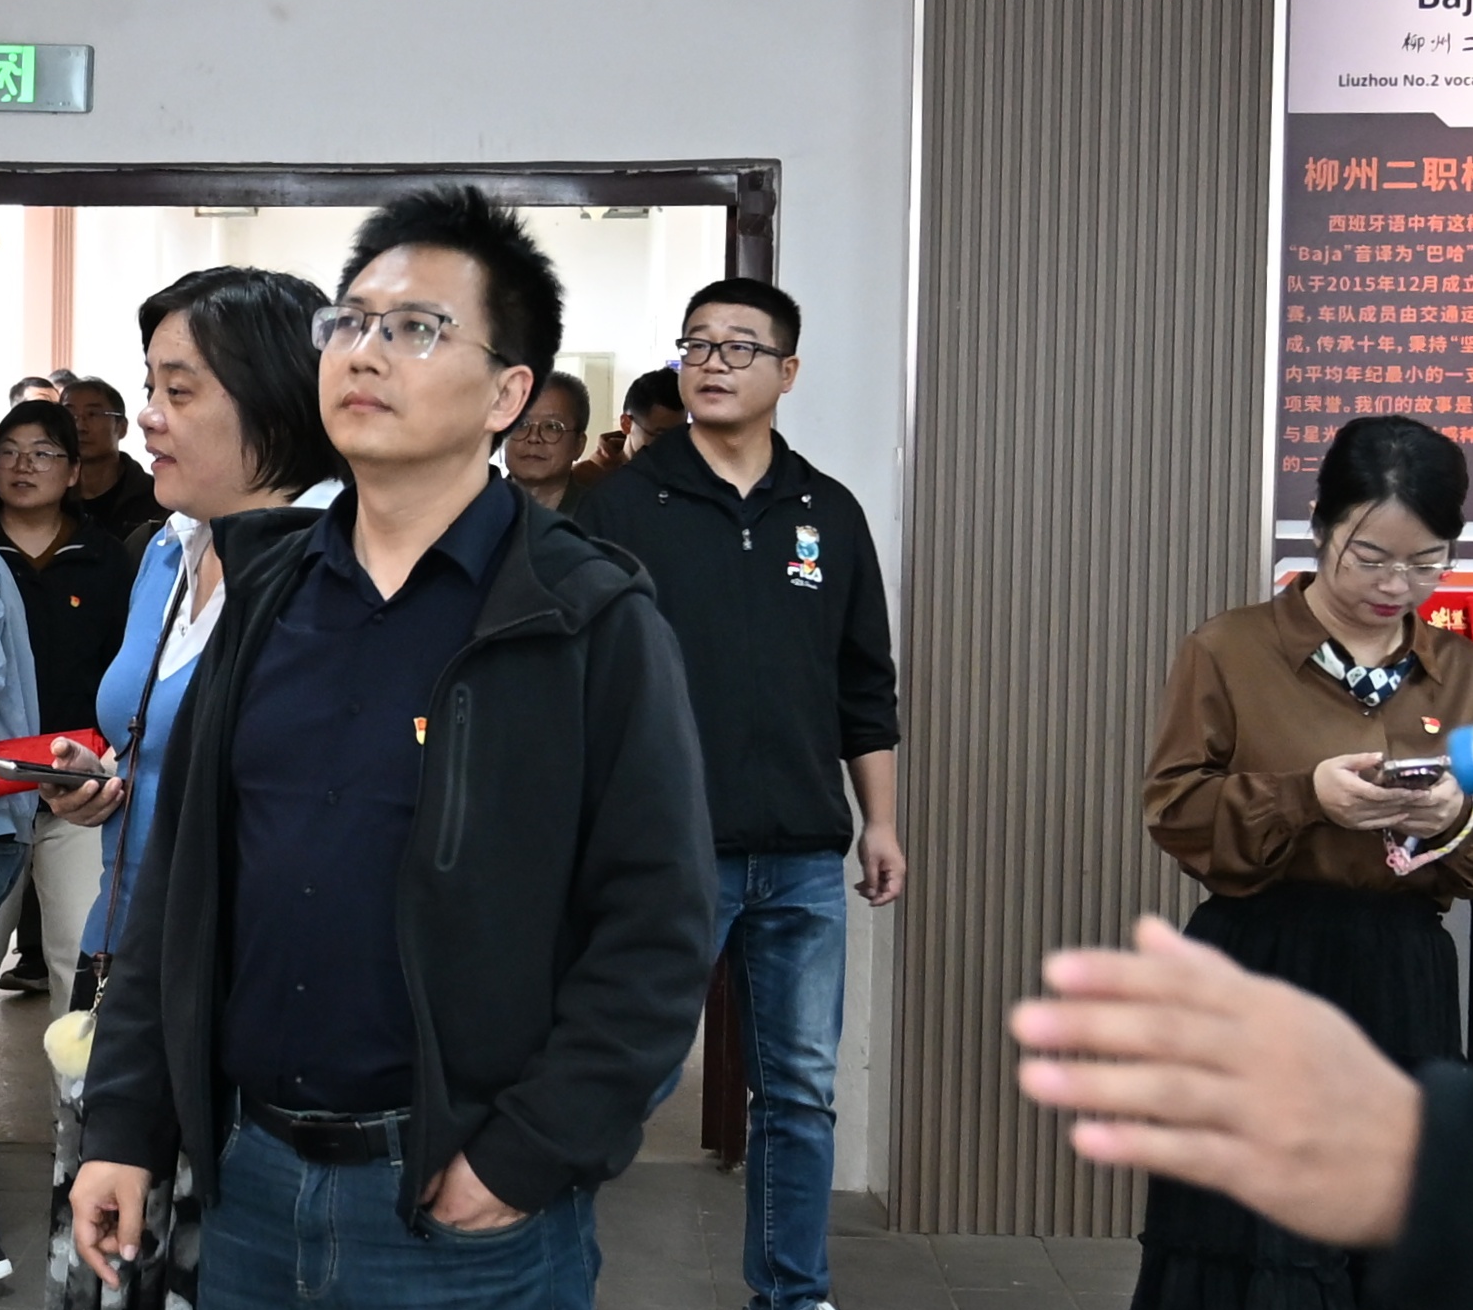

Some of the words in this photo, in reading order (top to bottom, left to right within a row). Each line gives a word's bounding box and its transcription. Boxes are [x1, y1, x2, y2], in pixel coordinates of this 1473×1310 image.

[1337, 71, 1399, 89] Liuzhou
[1403, 72, 1440, 87] No.2
[1282, 456, 1322, 474] 的二
